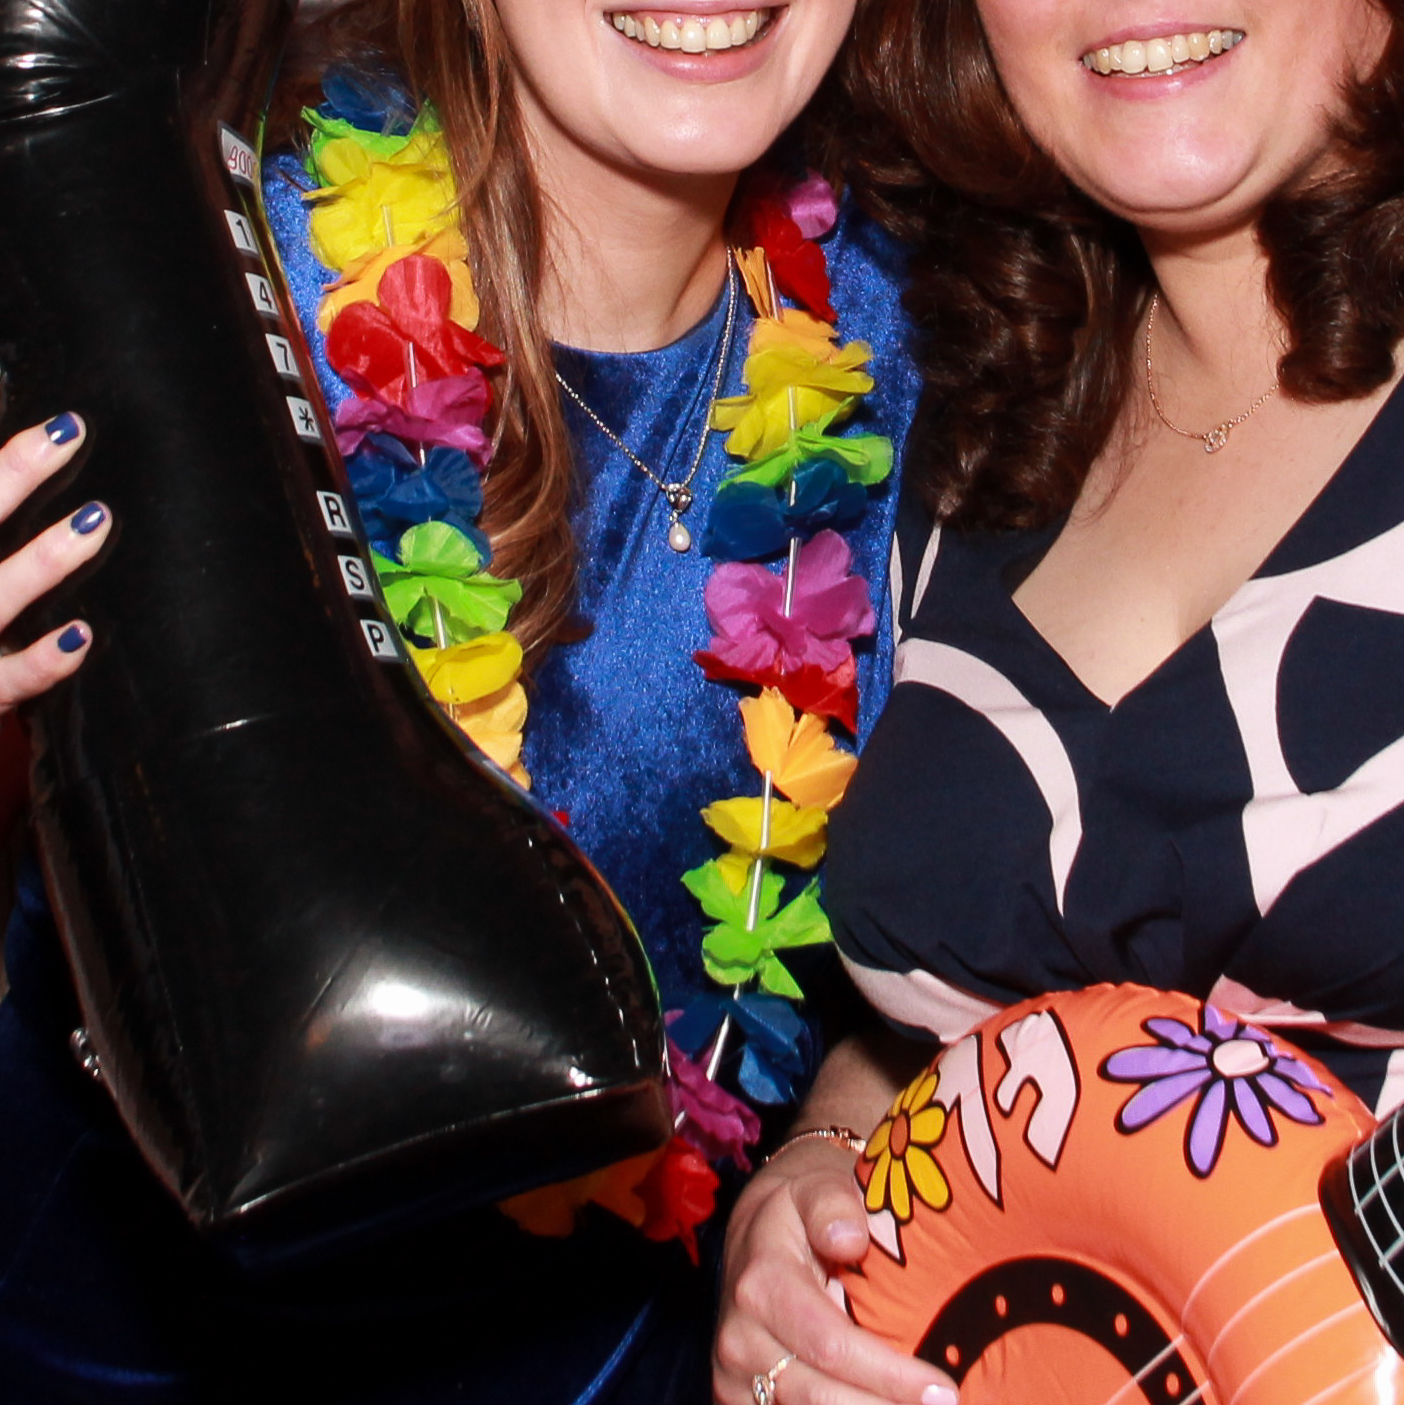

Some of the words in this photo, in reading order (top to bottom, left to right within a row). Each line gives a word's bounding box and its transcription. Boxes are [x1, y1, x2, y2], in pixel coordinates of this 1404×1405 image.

[235, 218, 251, 247] 1
[259, 281, 272, 310] 4
[276, 342, 290, 371] 7
[323, 496, 347, 528] R
[345, 559, 365, 590] S
[367, 623, 385, 653] P
